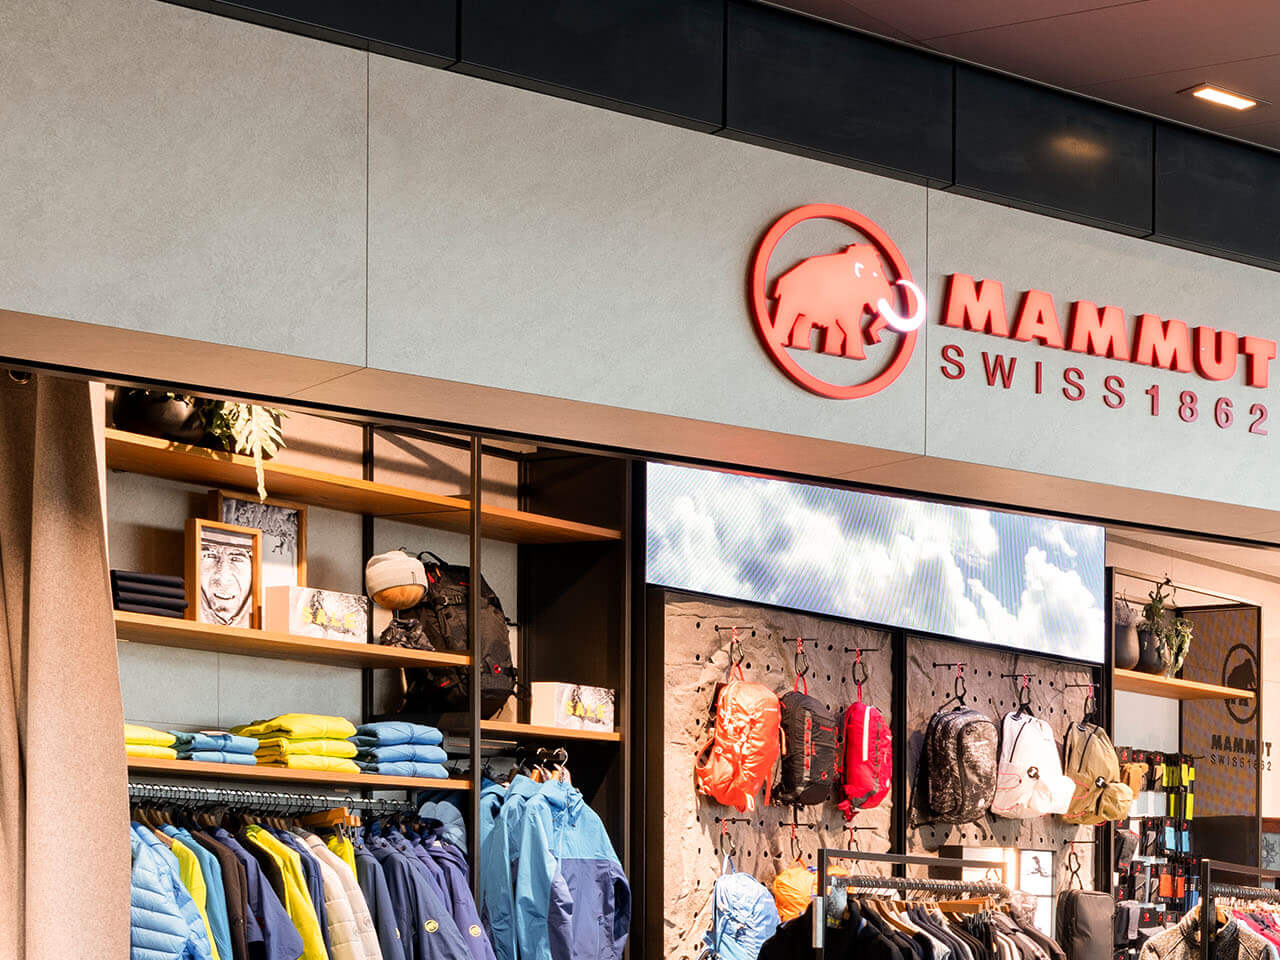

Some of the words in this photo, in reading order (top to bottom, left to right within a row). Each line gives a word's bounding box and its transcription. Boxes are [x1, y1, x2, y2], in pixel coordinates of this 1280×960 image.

[941, 273, 1278, 389] MAMMUT
[303, 606, 355, 628] SALE
[566, 700, 605, 718] SALE
[1211, 734, 1272, 757] MAMMT
